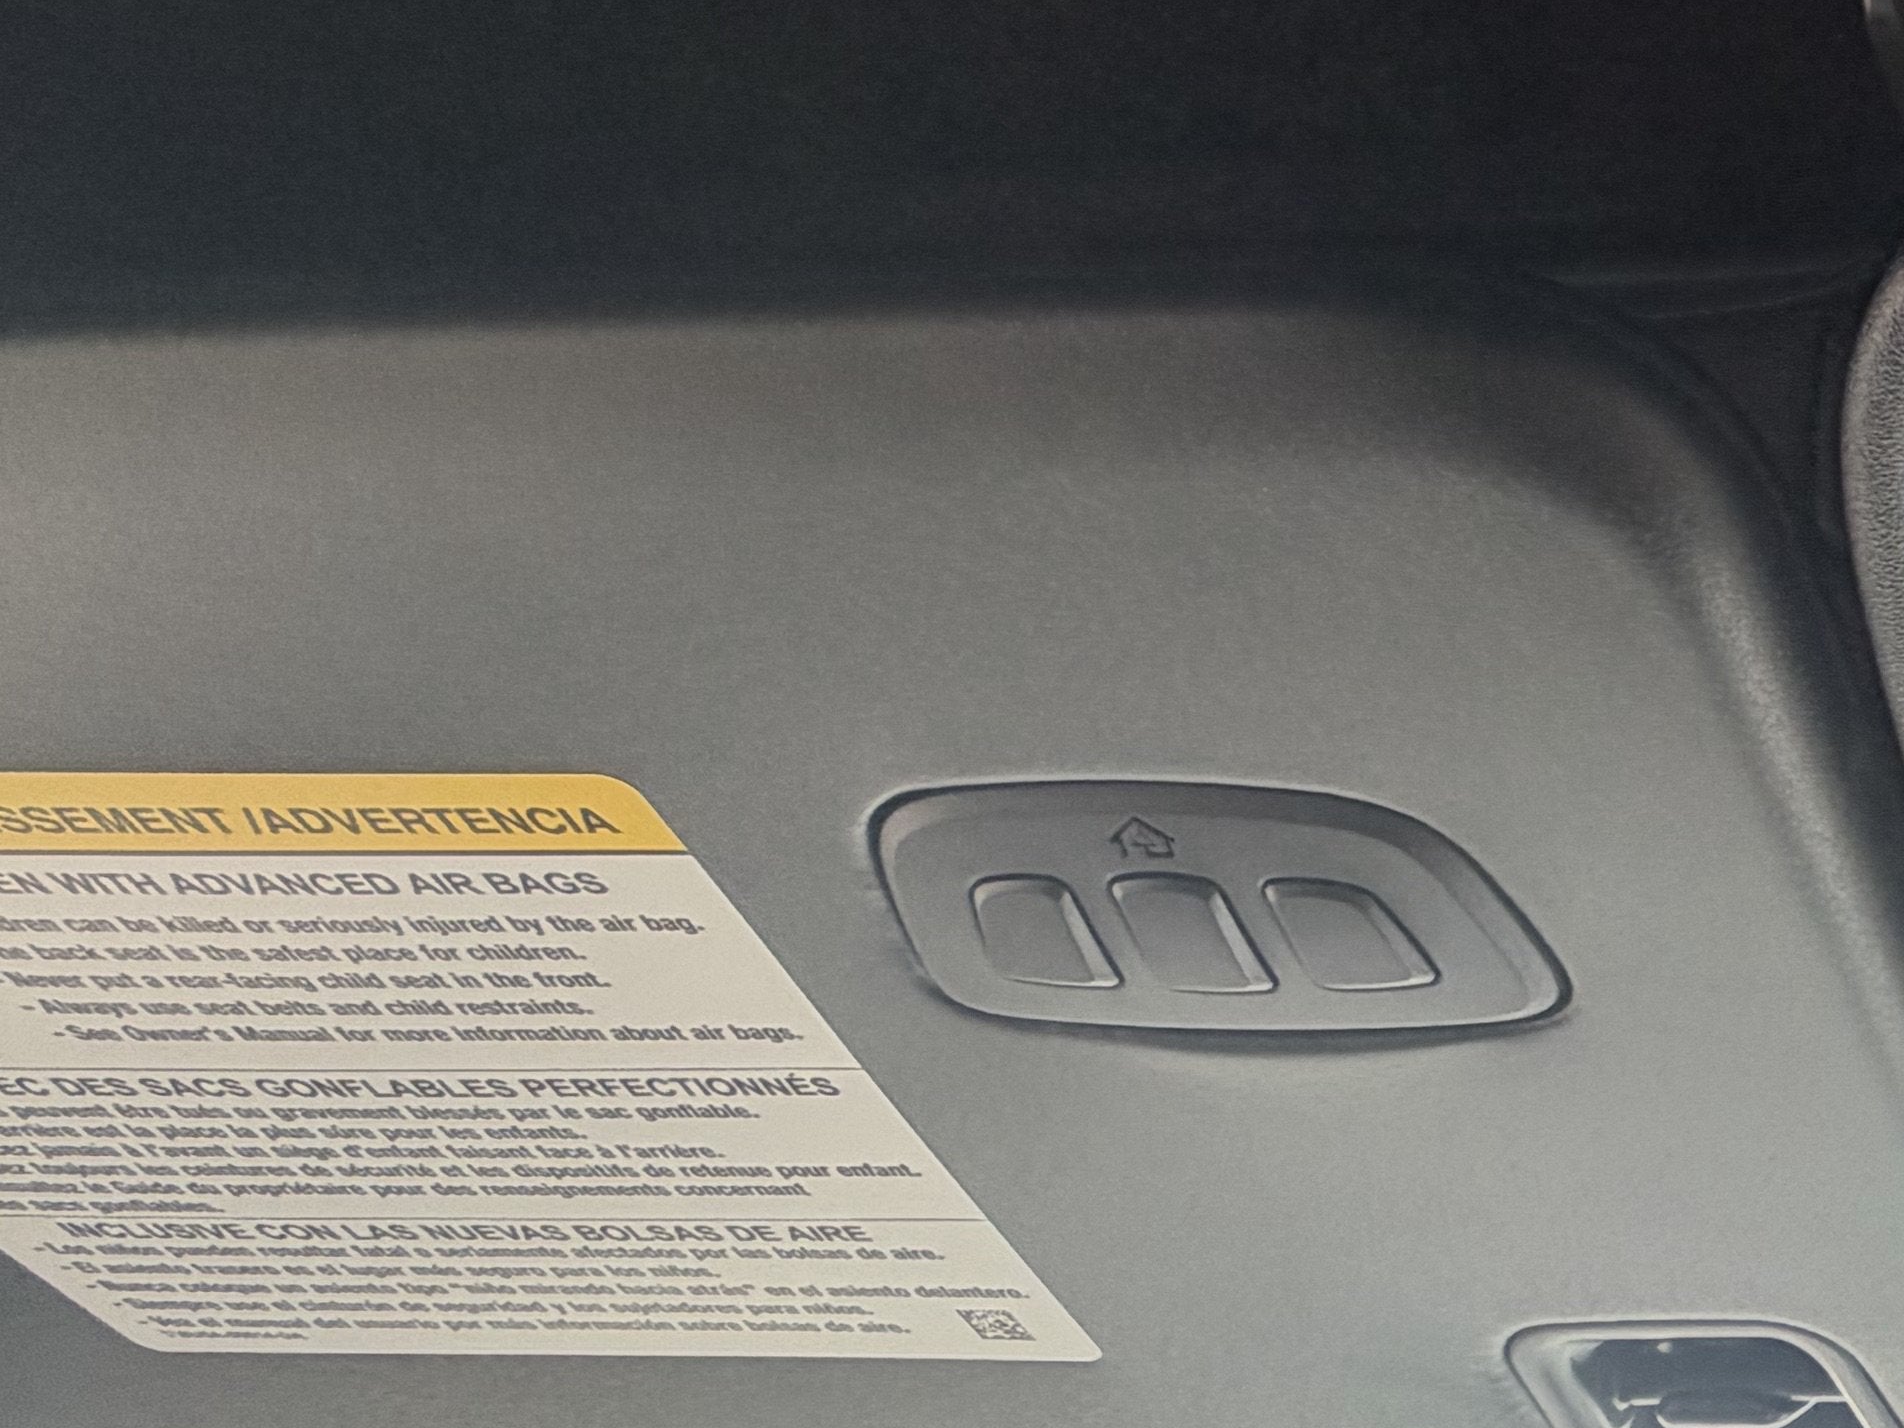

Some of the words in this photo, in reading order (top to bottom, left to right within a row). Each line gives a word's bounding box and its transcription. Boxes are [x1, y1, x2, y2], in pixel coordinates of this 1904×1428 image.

[45, 873, 168, 895] WITH
[169, 873, 401, 895] ADVANCED
[408, 873, 486, 894] AIR
[482, 872, 608, 894] BAGS
[63, 919, 119, 932] can
[115, 915, 160, 932] be
[156, 915, 243, 933] killed
[242, 920, 276, 933] or
[276, 915, 404, 936] seriously
[402, 915, 506, 936] injured
[504, 915, 548, 935] by
[545, 915, 597, 932] the
[598, 915, 638, 932] air
[638, 914, 705, 934] bag.
[104, 944, 172, 961] seat
[197, 944, 252, 961] the
[249, 944, 343, 961] safest
[341, 944, 419, 963] place
[418, 944, 461, 960] for
[465, 943, 588, 960] children.
[88, 973, 143, 991] put
[141, 976, 165, 988] a
[164, 972, 319, 993] rear-facing
[316, 972, 389, 988] child
[387, 973, 453, 988] seat
[446, 972, 487, 988] in
[482, 972, 533, 988] the
[532, 972, 612, 988] front.
[193, 1001, 260, 1015] seat
[253, 1000, 328, 1015] belts
[328, 1000, 383, 1015] and
[383, 999, 456, 1015] child
[454, 998, 595, 1015] restraints.
[333, 1026, 378, 1041] for
[379, 1030, 455, 1042] more
[448, 1025, 610, 1042] information
[609, 1024, 690, 1041] about
[690, 1024, 728, 1041] air
[726, 1023, 804, 1042] bags.
[49, 1077, 140, 1096] DES
[138, 1077, 253, 1097] SACS
[255, 1078, 519, 1098] GONFLABLES
[516, 1072, 841, 1097] PERFECTIONNÉS
[549, 1105, 583, 1120] le
[54, 1222, 258, 1240] INCLUSIVE
[254, 1223, 343, 1241] CON
[339, 1224, 421, 1241] LAS
[418, 1224, 572, 1242] NUEVAS
[571, 1225, 726, 1242] BOLSAS
[724, 1225, 783, 1242] DE
[788, 1225, 875, 1243] AIRE
